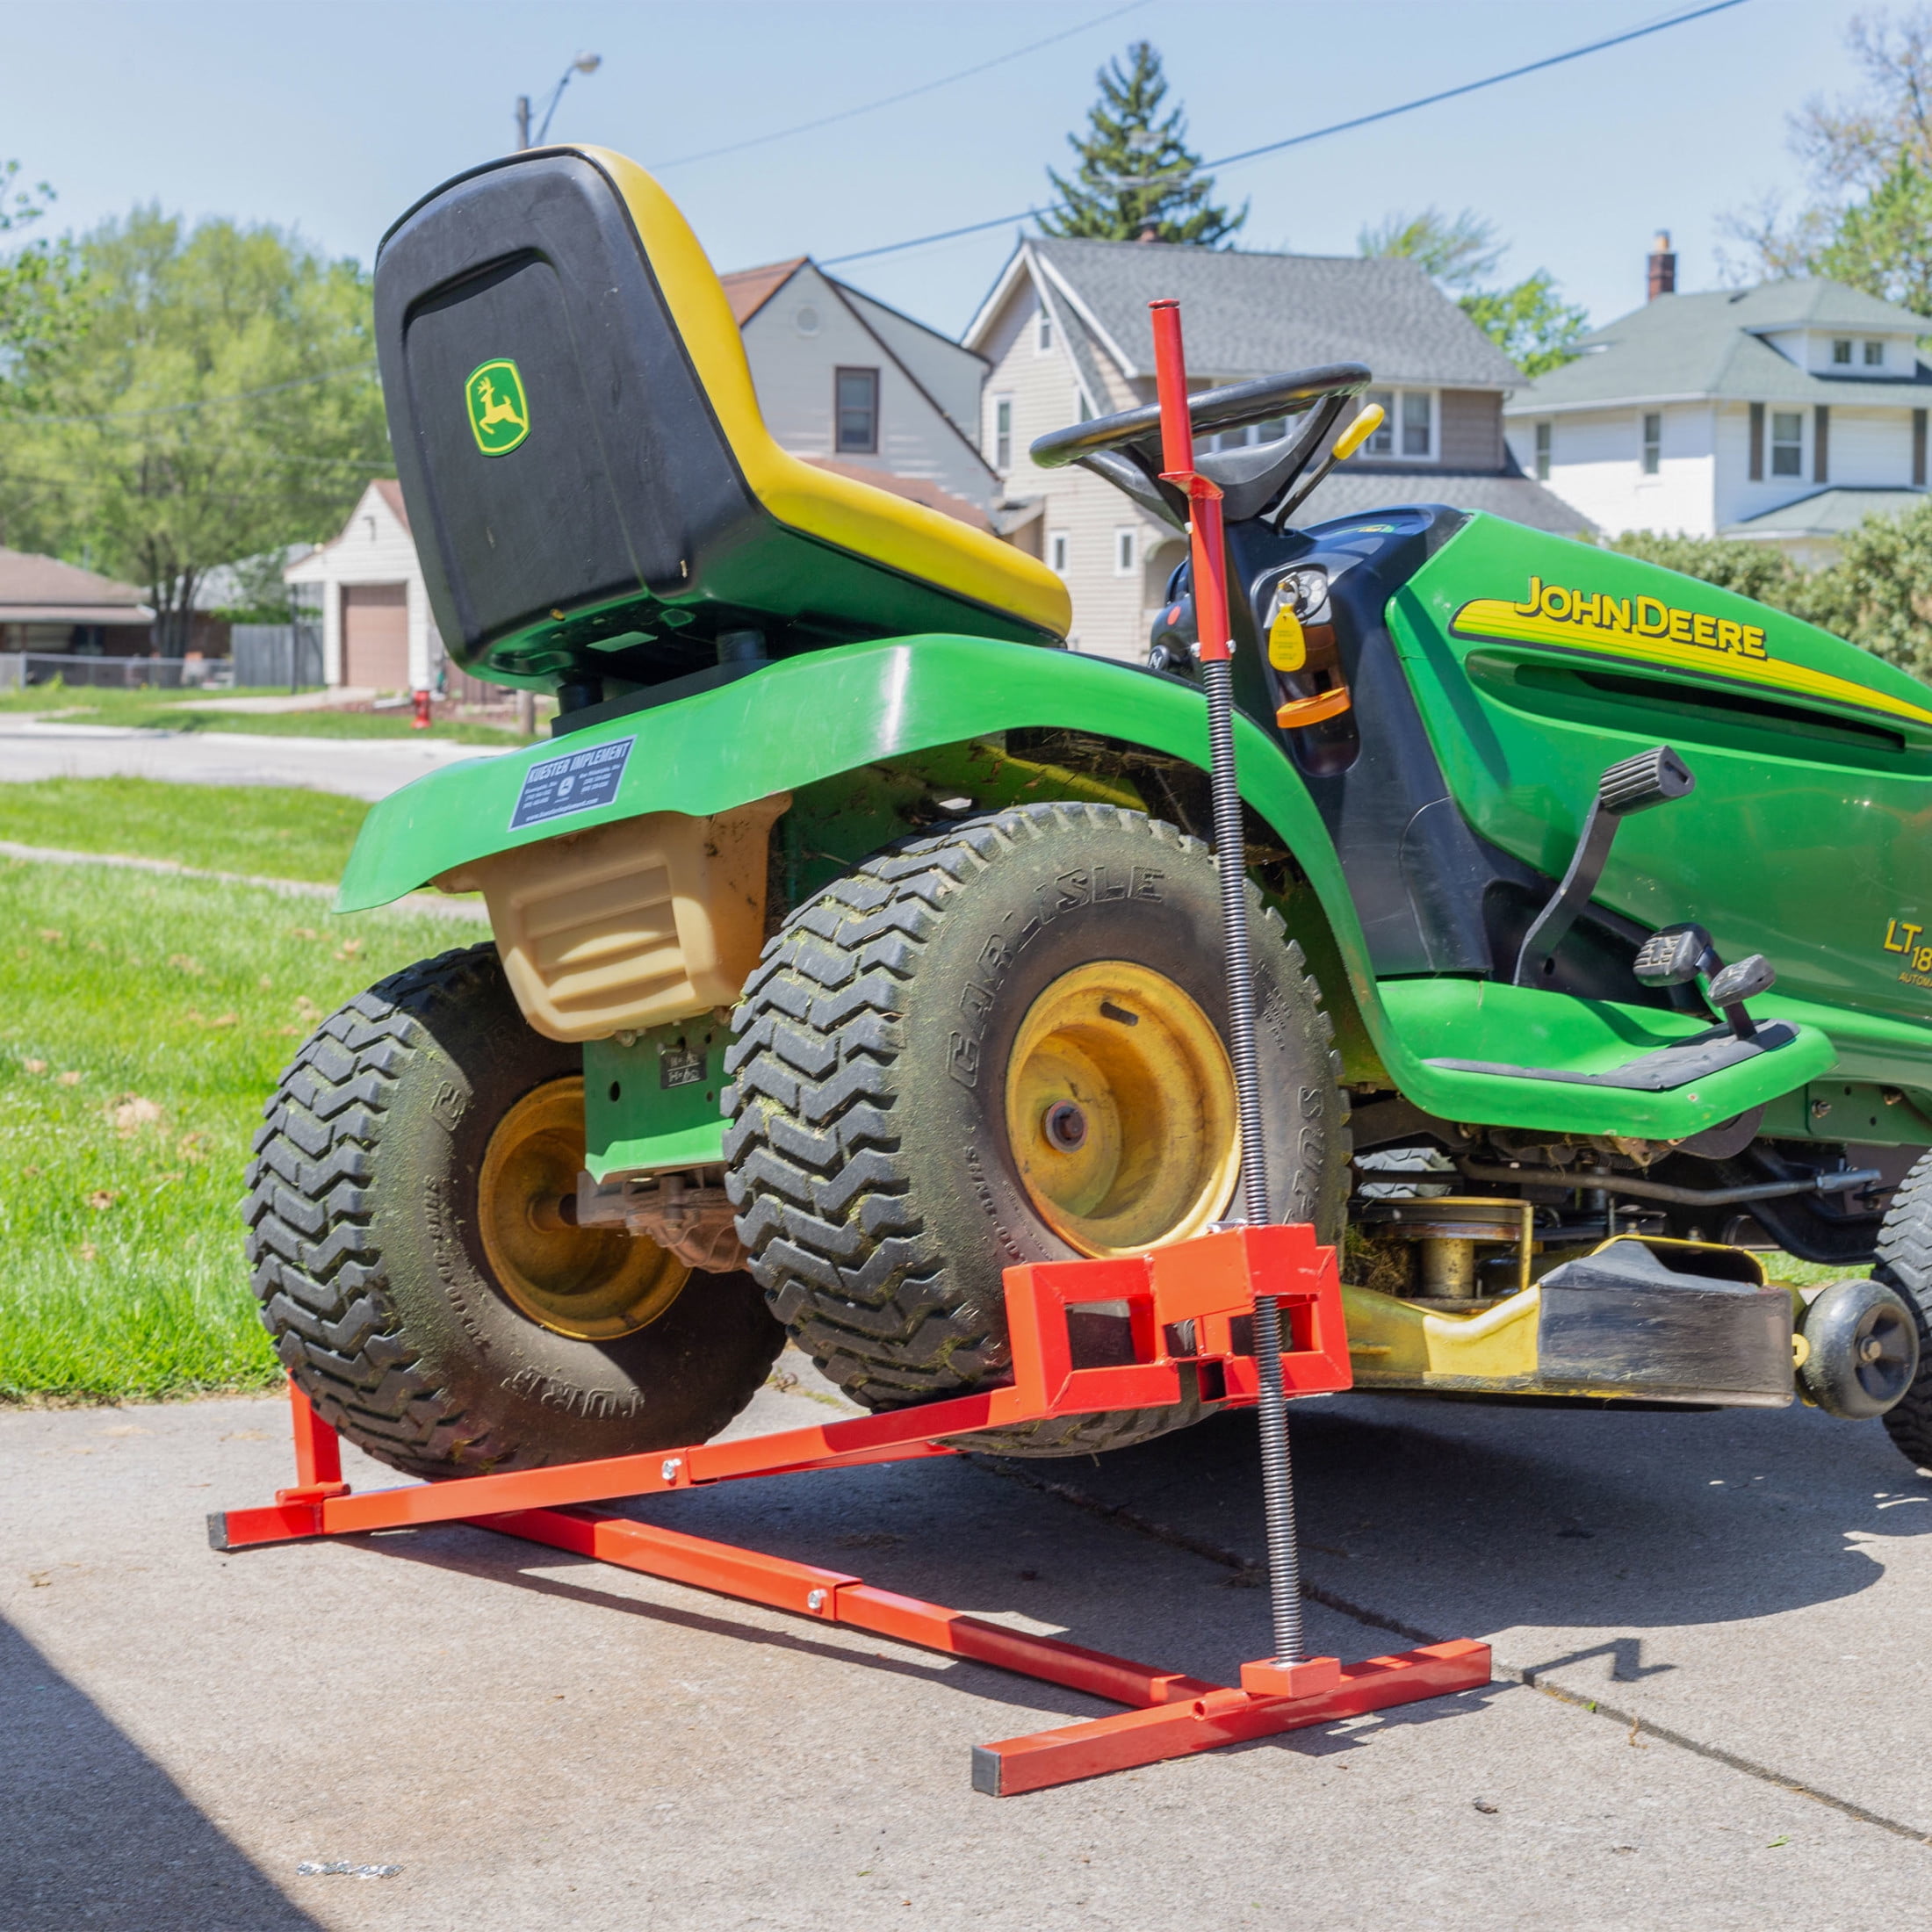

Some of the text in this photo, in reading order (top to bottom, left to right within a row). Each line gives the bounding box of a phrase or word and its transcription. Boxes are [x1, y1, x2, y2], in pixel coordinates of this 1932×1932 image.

[1514, 576, 1768, 662] JOHN DEERE
[569, 742, 631, 773] IMPLEMENT
[946, 865, 1166, 1089] CARLISLE
[1883, 918, 1932, 974] LT 18
